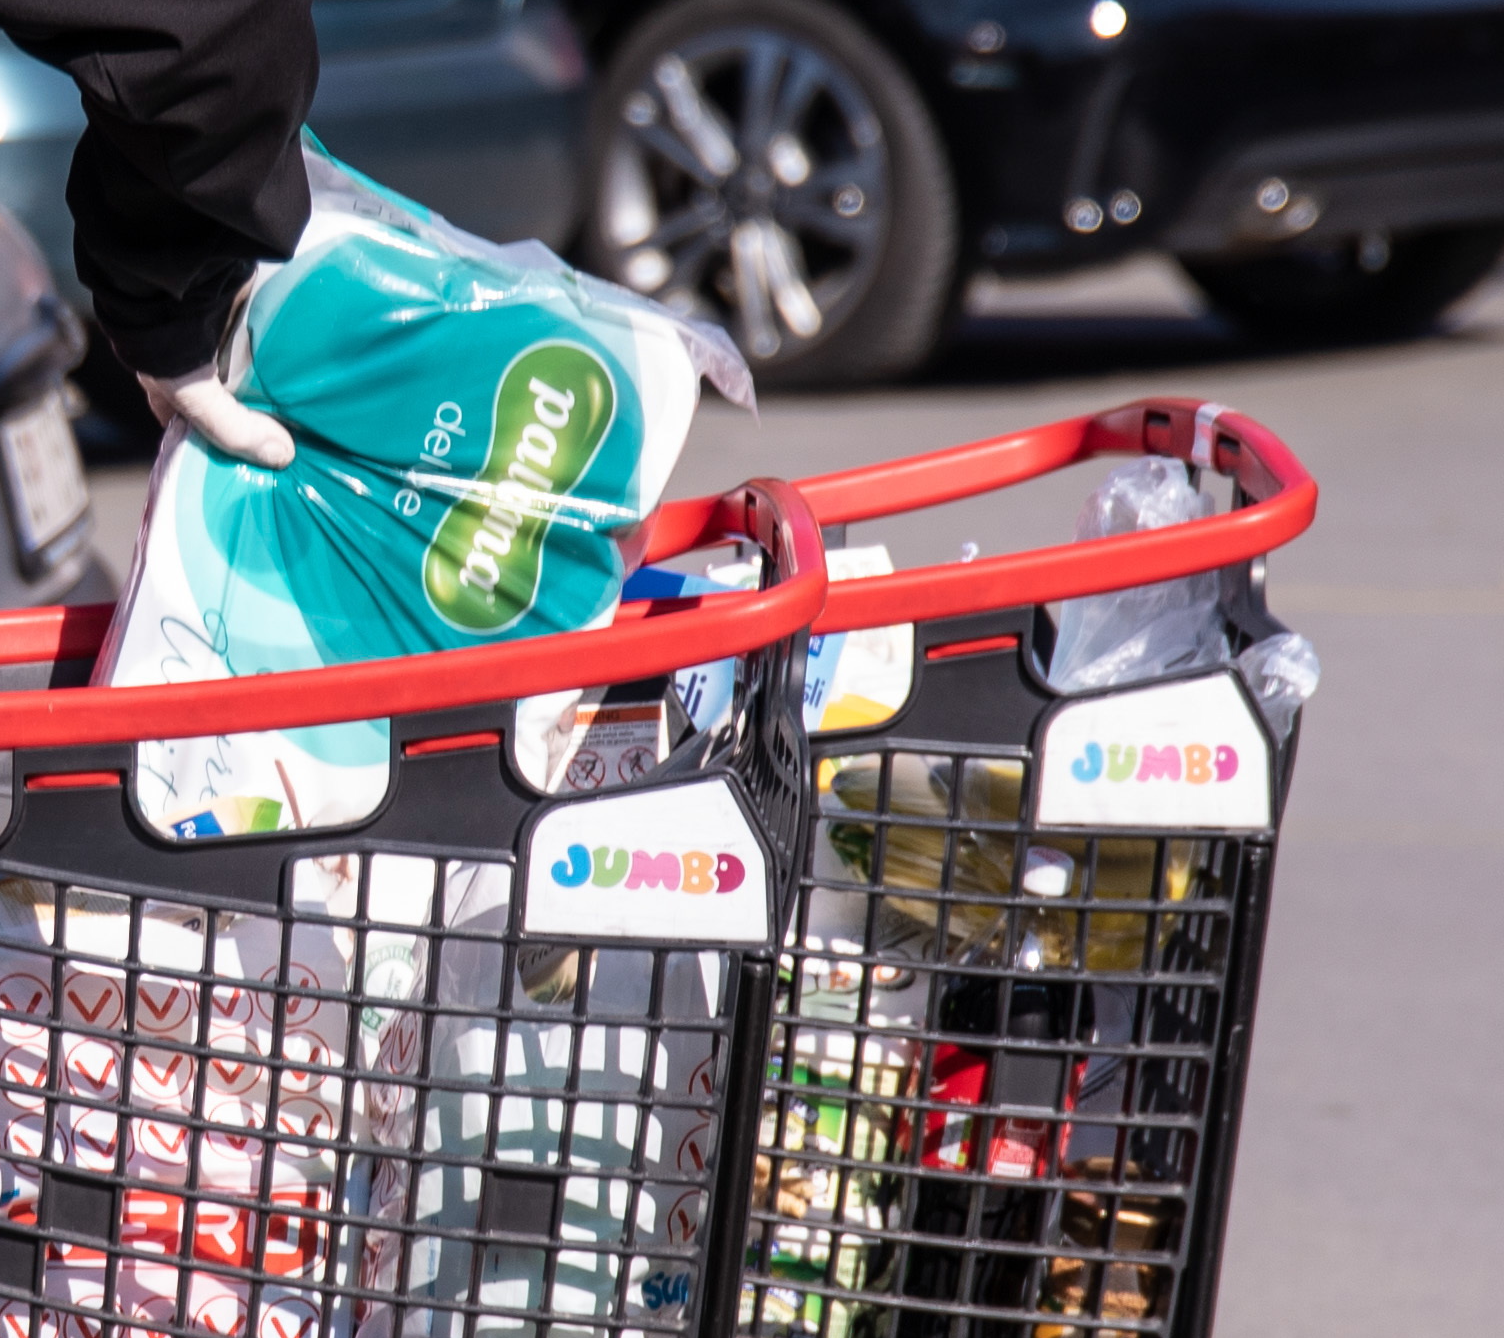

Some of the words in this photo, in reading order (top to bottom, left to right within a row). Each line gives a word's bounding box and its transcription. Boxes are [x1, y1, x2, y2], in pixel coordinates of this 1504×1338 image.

[1072, 742, 1239, 785] JUMBO
[551, 844, 745, 895] JUMBO
[55, 1198, 300, 1256] ERO
